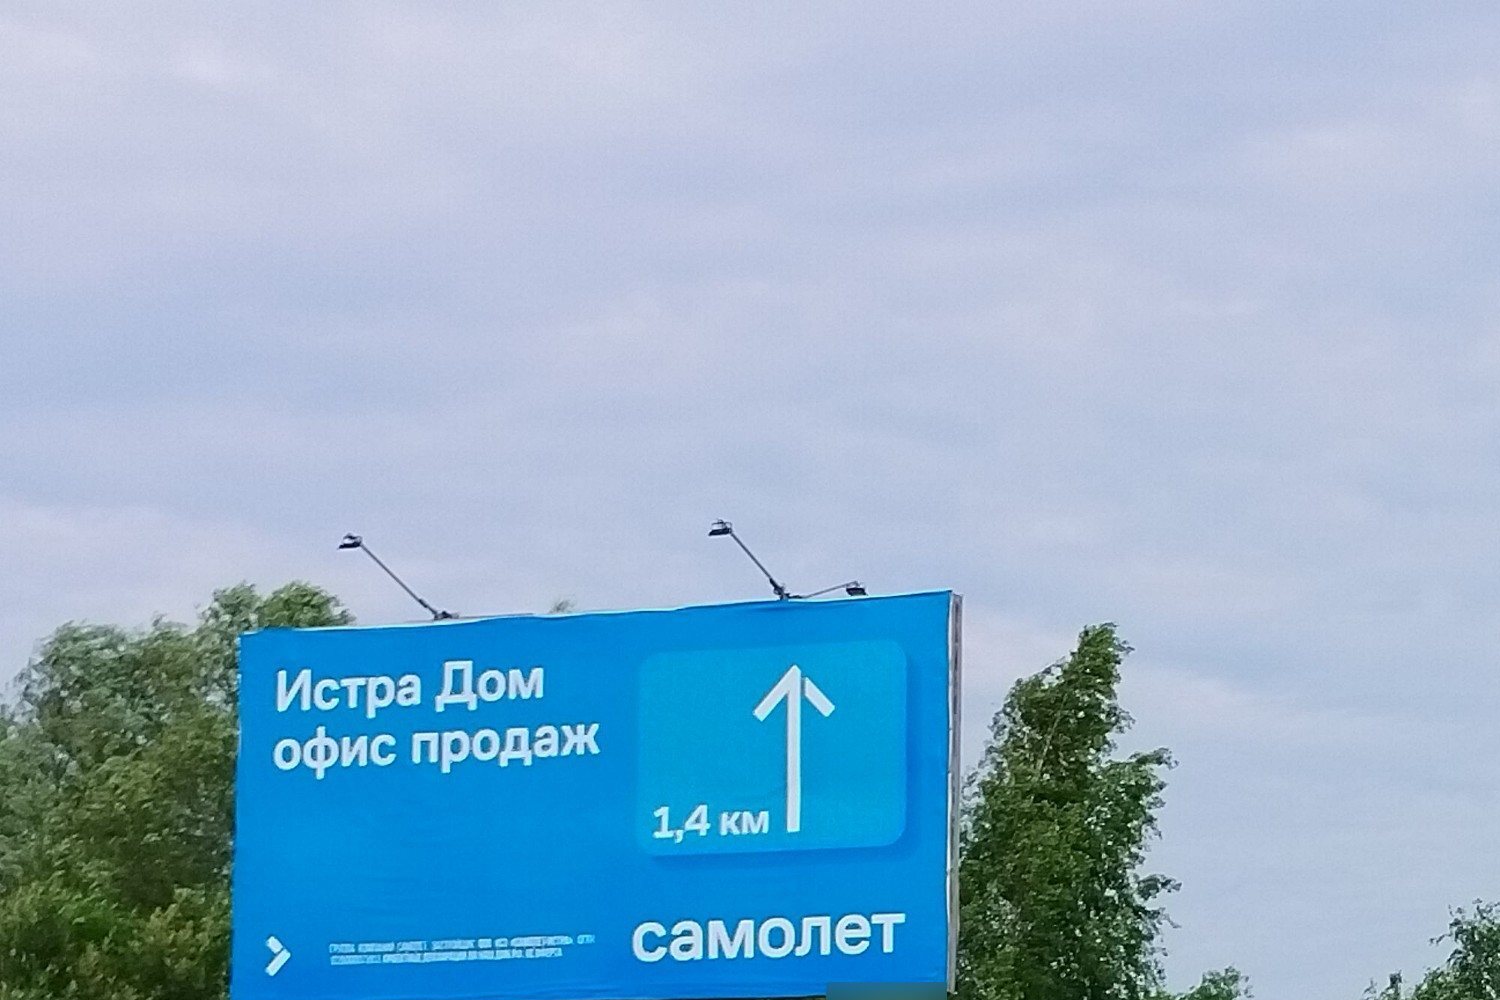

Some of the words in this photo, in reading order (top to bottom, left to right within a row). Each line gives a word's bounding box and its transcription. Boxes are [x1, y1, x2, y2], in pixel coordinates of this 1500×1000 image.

[276, 667, 421, 719] Истра
[434, 660, 544, 712] Дом
[273, 726, 396, 780] офис
[411, 723, 600, 774] продаж
[653, 804, 711, 843] 1,4
[719, 810, 769, 837] км
[632, 913, 906, 962] самолет
